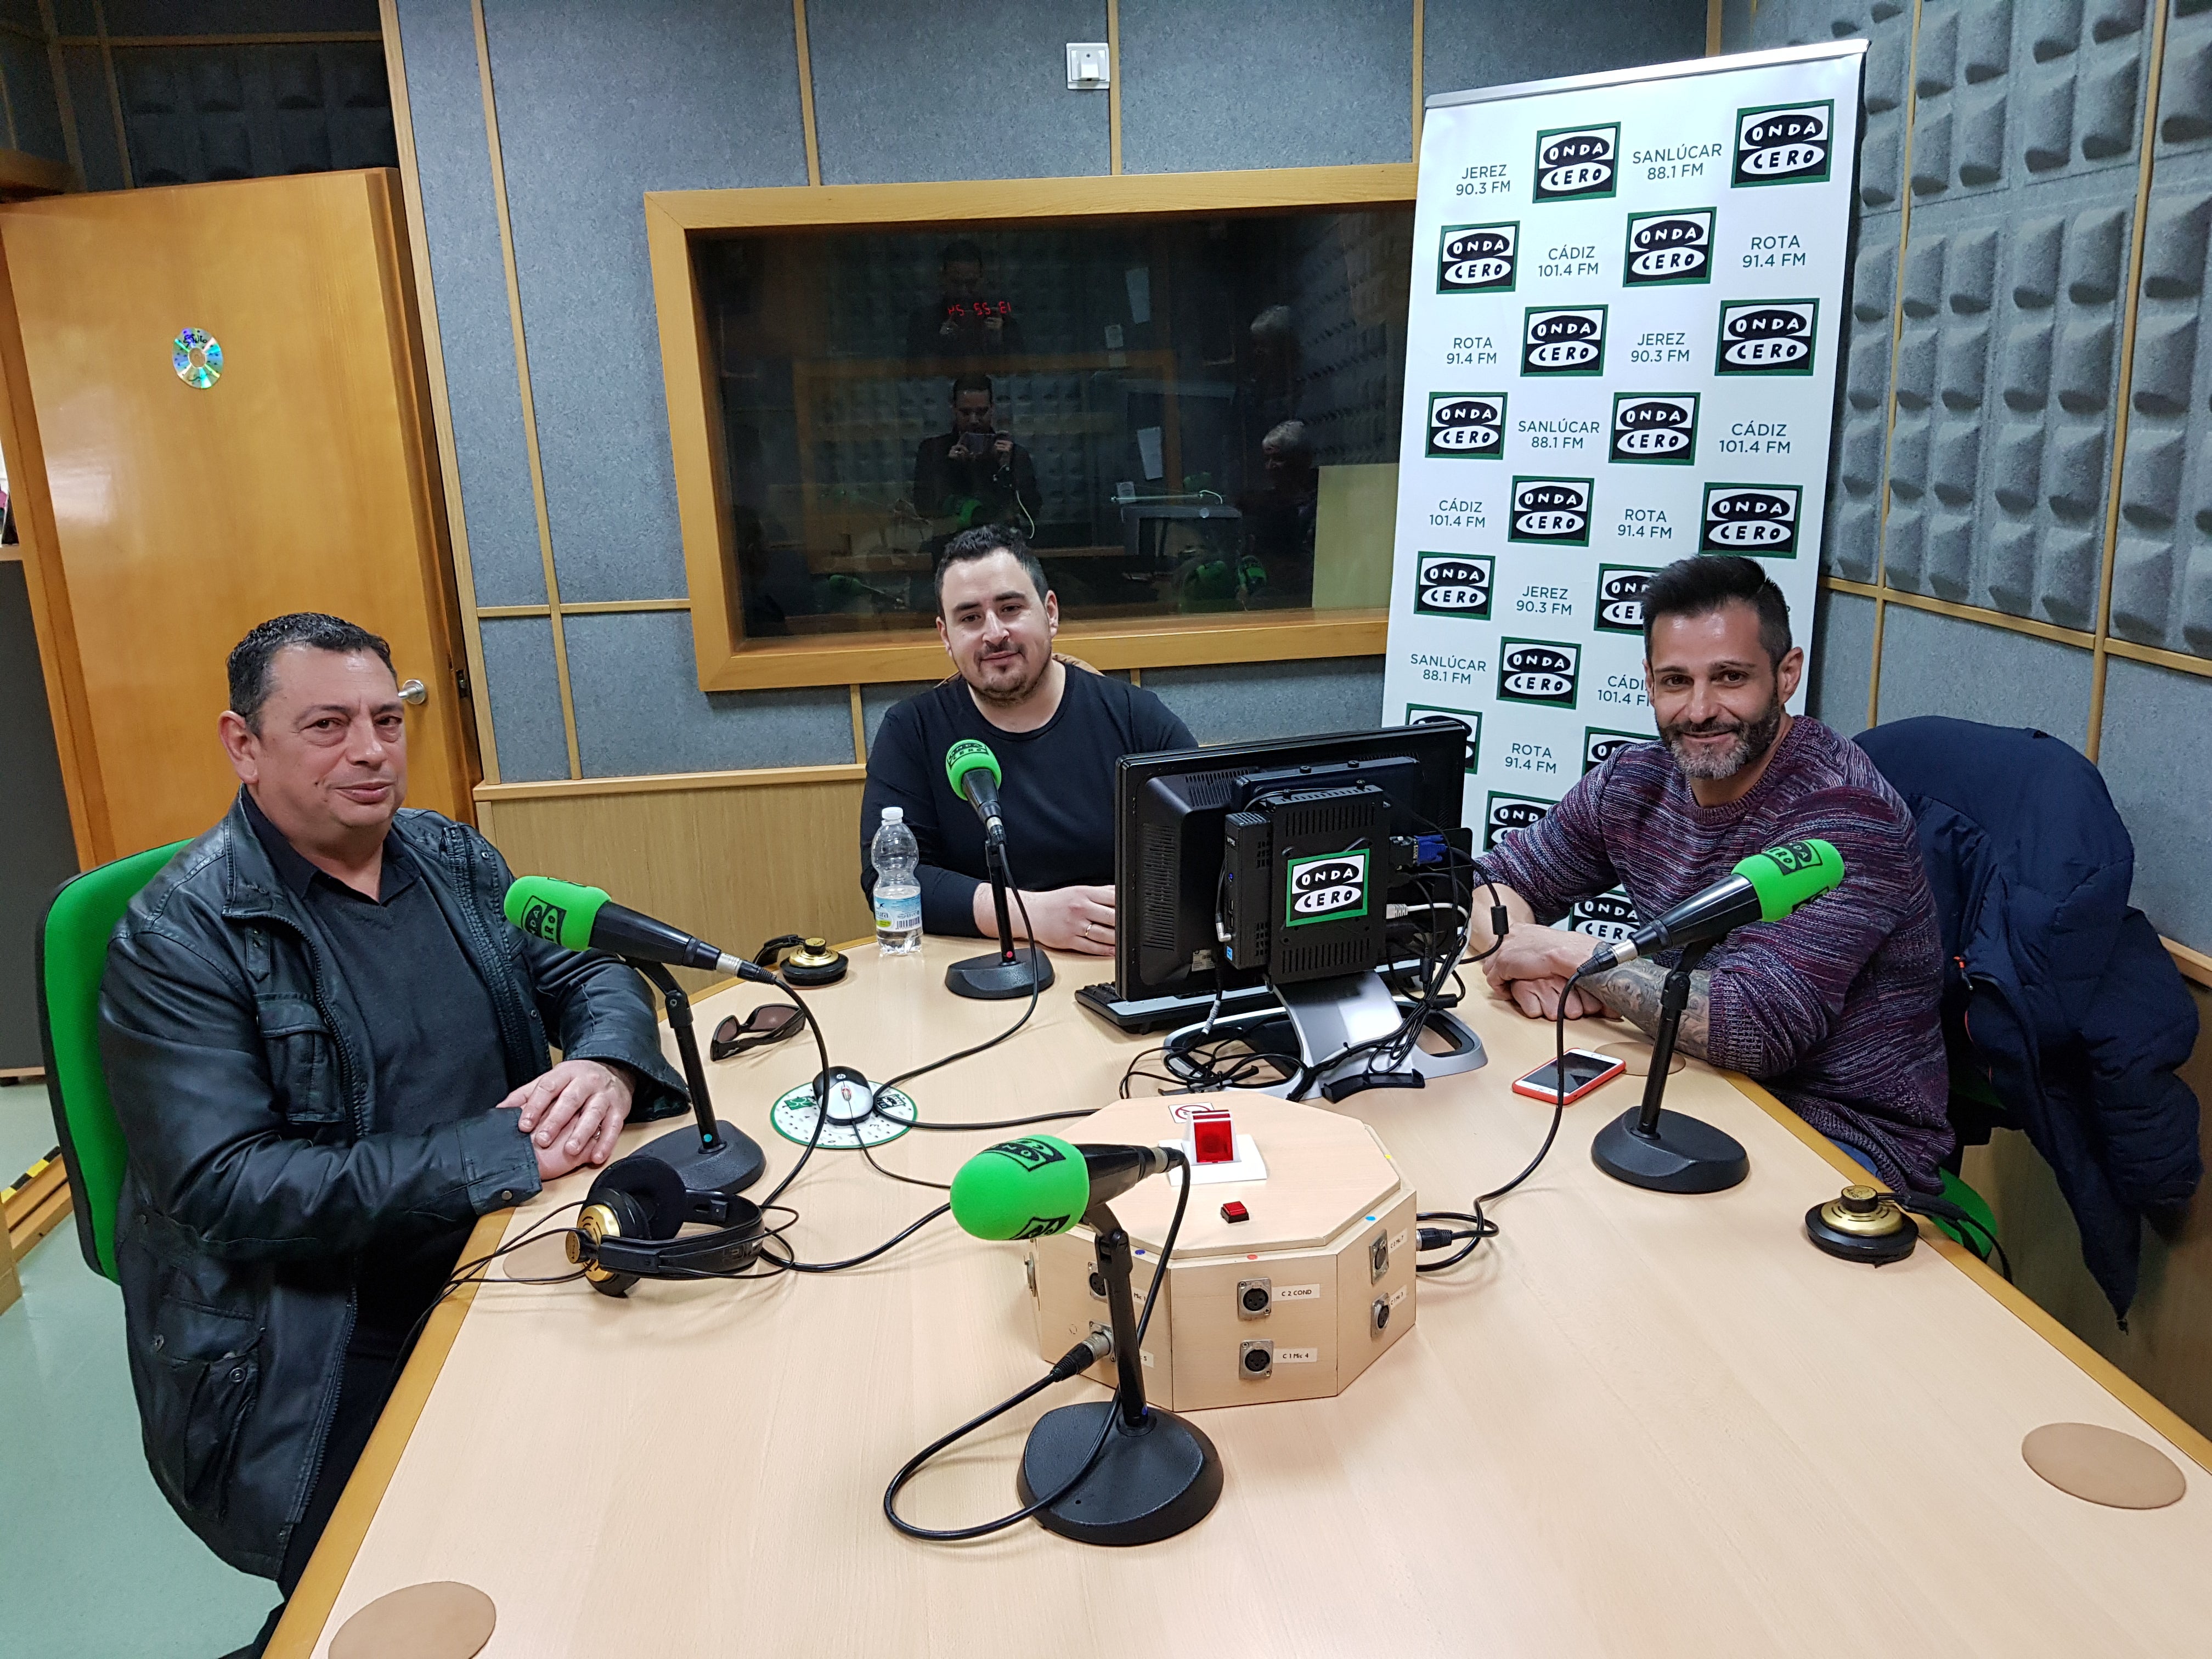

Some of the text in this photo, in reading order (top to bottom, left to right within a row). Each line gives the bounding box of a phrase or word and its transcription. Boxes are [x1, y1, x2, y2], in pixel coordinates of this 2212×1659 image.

[1752, 122, 1815, 140] ONDA
[1550, 143, 1602, 160] ONDA
[1633, 144, 1722, 163] SANLÚCAR
[1754, 150, 1814, 168] CERO
[1462, 165, 1506, 179] JEREZ
[1551, 168, 1601, 185] CERO
[1648, 163, 1703, 180] 88.1 FM
[1457, 180, 1510, 195] 90.3 FM
[1641, 227, 1696, 244] ONDA
[1751, 235, 1800, 250] ROTA
[1453, 240, 1503, 254] ONDA
[1549, 245, 1595, 259] CÁDIZ
[1643, 253, 1694, 269] CERO
[1743, 253, 1805, 268] 91.4 FM
[1455, 264, 1502, 278] CERO
[1539, 263, 1598, 276] 101.4 FM
[1538, 323, 1590, 336] ONDA
[1736, 318, 1798, 332] ONDA
[1454, 337, 1492, 348] ROTA
[1638, 333, 1685, 345] JEREZ
[1447, 353, 1497, 364] 91.4 FM
[1539, 347, 1588, 361] CERO
[1632, 350, 1689, 362] 90.3 FM
[1737, 344, 1797, 359] CERO
[1442, 409, 1491, 420] ONDA
[1627, 410, 1680, 422] ONDA
[1519, 419, 1599, 433] SANLÚCAR
[1732, 421, 1786, 437] CÁDIZ
[1443, 431, 1490, 443] CERO
[1532, 437, 1583, 449] 88.1 FM
[1627, 435, 1678, 448] CERO
[1719, 441, 1790, 453] 101.4 FM
[1440, 498, 1482, 512] CÁDIZ
[1525, 493, 1576, 504] ONDA
[1719, 501, 1782, 514] ONDA
[1430, 515, 1485, 527] 101.4 FM
[1526, 516, 1575, 529] CERO
[1626, 509, 1666, 522] ROTA
[1618, 524, 1672, 539] 91.4 FM
[1721, 526, 1780, 540] CERO
[1430, 568, 1479, 580] ONDA
[1522, 586, 1568, 600] JEREZ
[1611, 582, 1650, 594] ON
[1431, 590, 1477, 603] CERO
[1517, 600, 1571, 615] 90.3 FM
[1612, 605, 1644, 619] CE
[1411, 654, 1486, 672] SANLÚCAR
[1513, 654, 1564, 668] ONDA
[1423, 669, 1470, 684] 88.1 FM
[1514, 676, 1562, 691] CERO
[1608, 675, 1646, 691] CÁDI
[1598, 690, 1649, 707] 101.4 F
[1512, 743, 1551, 758] ROTA
[1505, 757, 1556, 774] 91.4 FM
[1499, 808, 1538, 822] OND
[1769, 848, 1793, 864] ERO
[1302, 868, 1352, 885] ONDA
[1304, 890, 1352, 907] CERO
